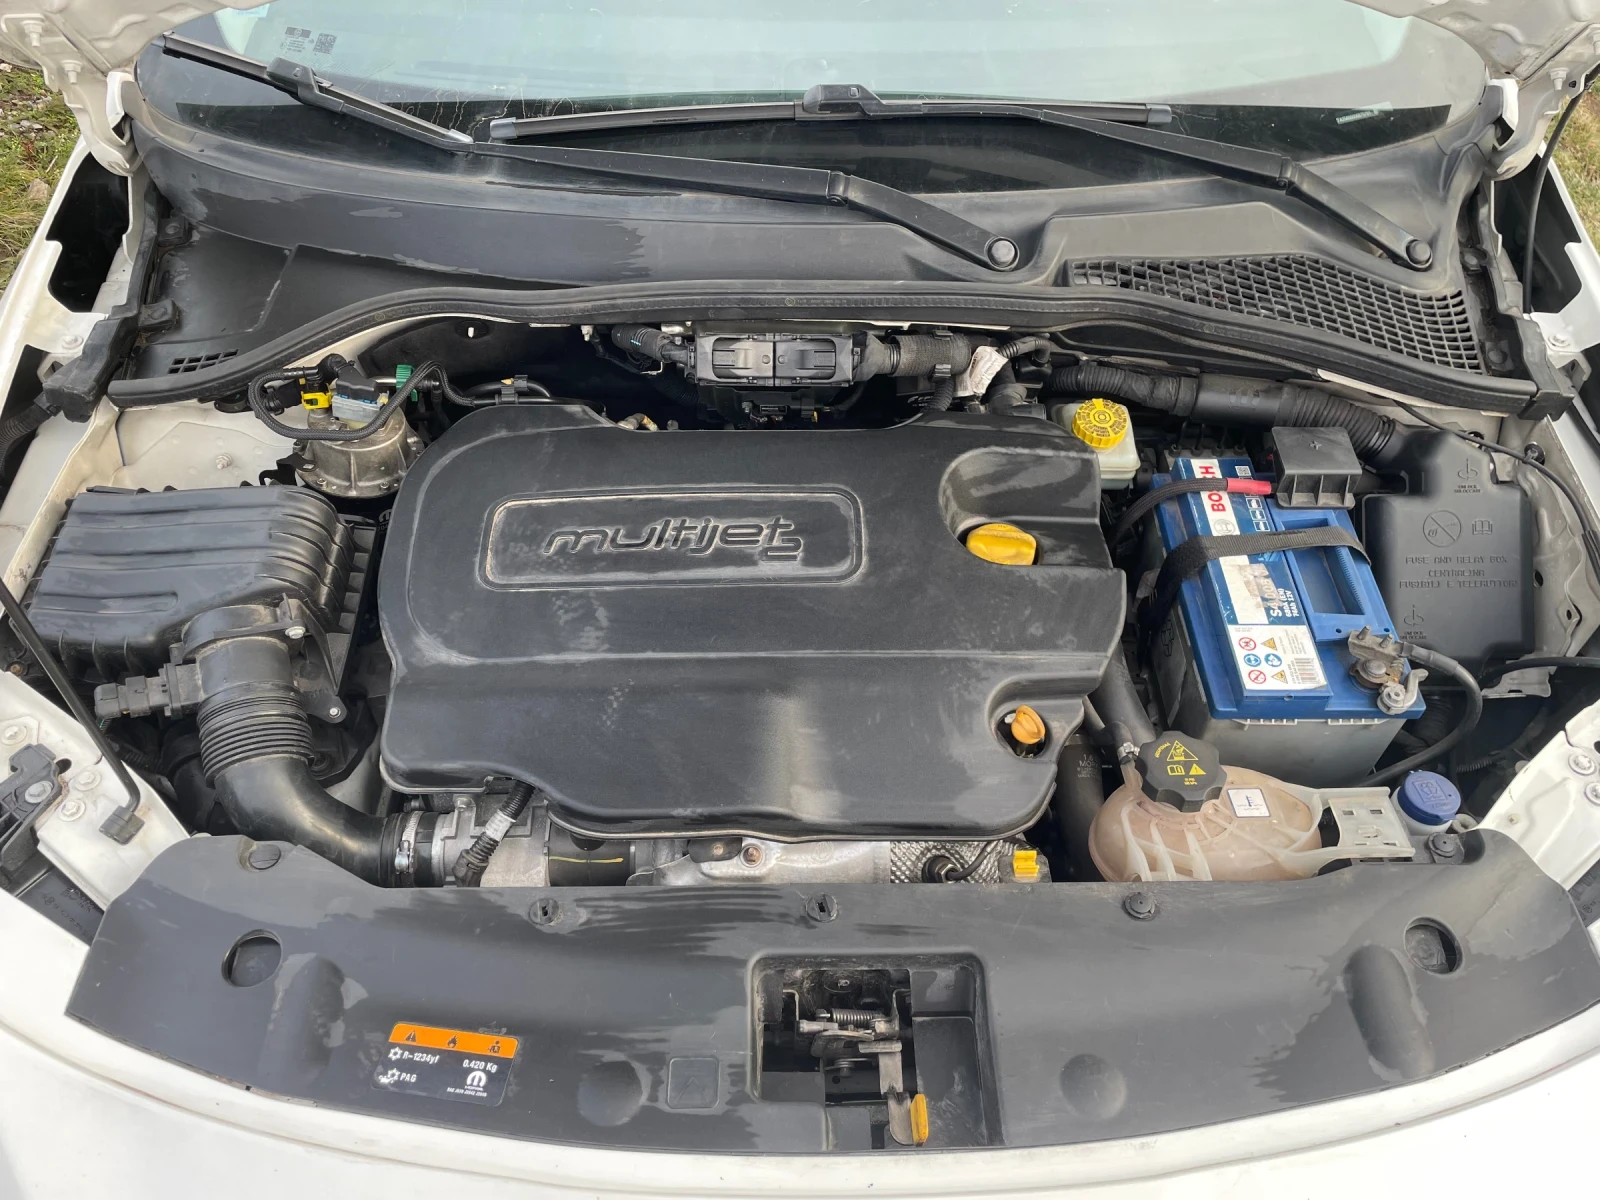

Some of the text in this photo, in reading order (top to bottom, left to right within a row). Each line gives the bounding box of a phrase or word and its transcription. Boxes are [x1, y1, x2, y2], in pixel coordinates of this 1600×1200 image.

[1198, 465, 1227, 513] BOH
[1405, 556, 1508, 565] FUSE AND RELAY BOX
[1428, 569, 1485, 577] CENTRALINA
[402, 1051, 440, 1065] R-1234yf
[462, 1059, 498, 1073] 0.420 Kg
[400, 1072, 418, 1083] PAG
